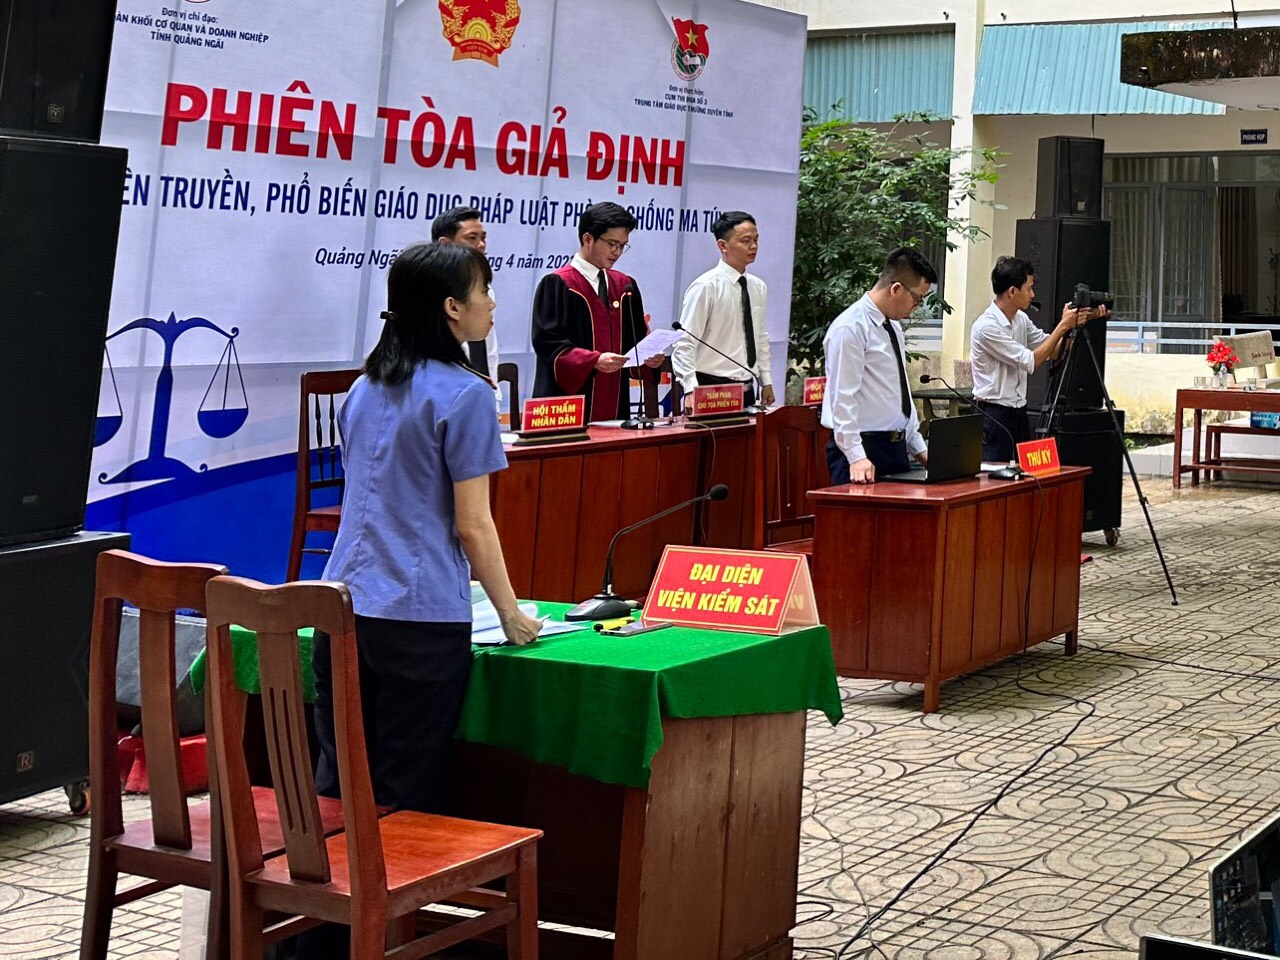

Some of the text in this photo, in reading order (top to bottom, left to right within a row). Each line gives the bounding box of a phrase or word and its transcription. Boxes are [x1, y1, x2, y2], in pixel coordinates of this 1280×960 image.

[162, 7, 178, 19] Đơn
[179, 10, 187, 22] vị
[115, 10, 129, 23] ÀN
[131, 14, 153, 27] KHỐI
[170, 21, 193, 34] QUAN
[195, 23, 207, 35] VÀ
[208, 27, 237, 39] DOANH
[238, 31, 269, 44] NGHIỆP
[151, 28, 172, 42] TỈNH
[173, 32, 202, 47] QUẢNG
[161, 80, 686, 195] PHIÊN TÒA GIẢ ĐỊNH
[160, 168, 256, 217] TRUYỀN,
[266, 171, 311, 214] PHỔ
[318, 177, 367, 217] BIẾN
[374, 186, 418, 220] GIÁO
[469, 192, 513, 224] PHÁP
[519, 195, 559, 230] LUẬT
[679, 208, 699, 233] MA
[315, 246, 365, 269] Quảng
[368, 249, 402, 269] Ngã
[505, 253, 514, 269] 4
[517, 253, 542, 269] năm
[533, 400, 576, 416] HỘI THẨM
[531, 413, 576, 427] NHÂN DÂN
[1041, 445, 1052, 465] KÝ
[689, 562, 764, 587] ĐẠI DIỆN
[657, 587, 697, 612] VIỆN
[697, 588, 743, 614] KIỂM
[744, 593, 780, 616] SÁT
